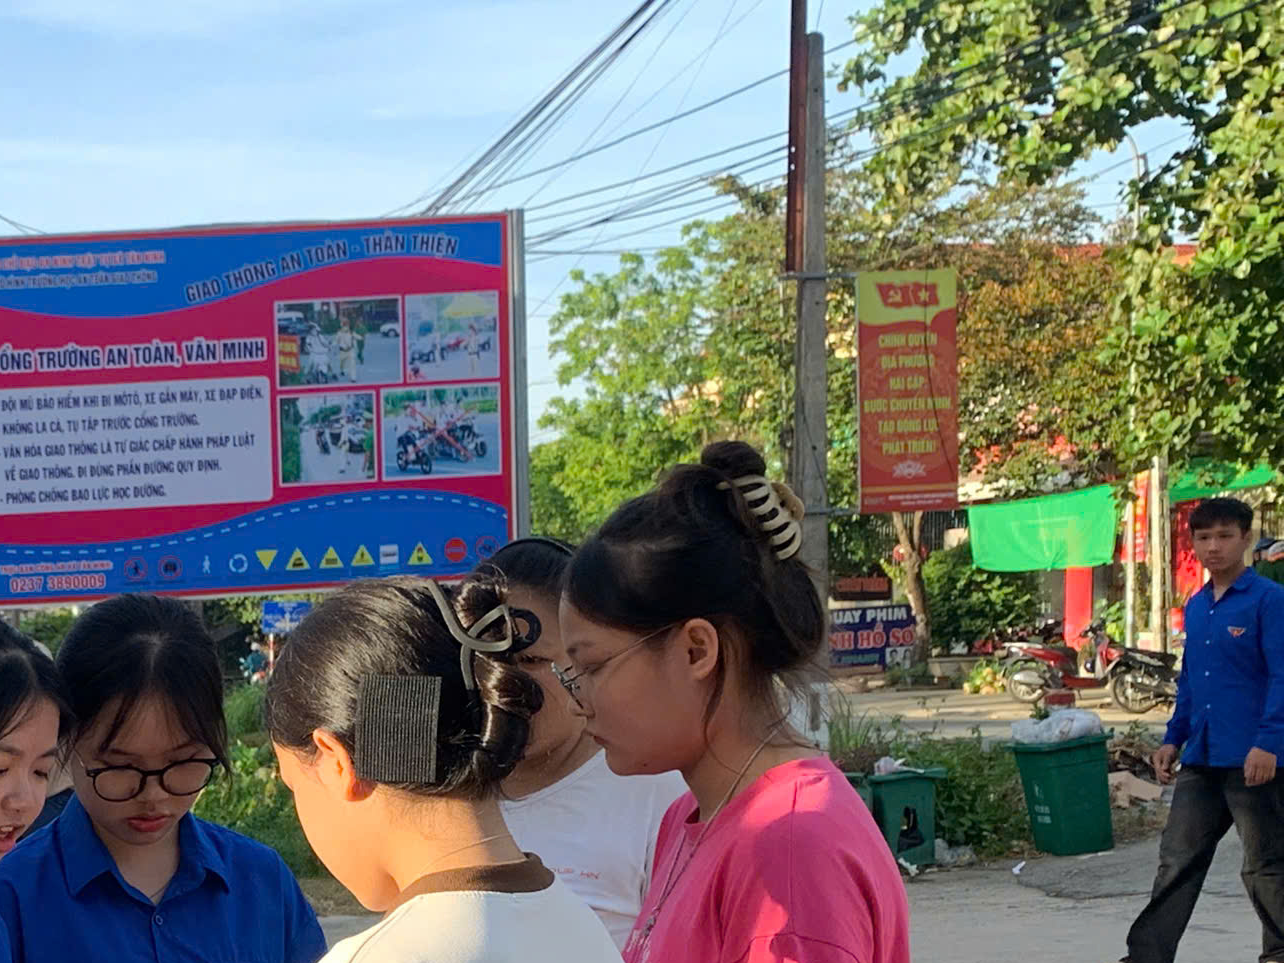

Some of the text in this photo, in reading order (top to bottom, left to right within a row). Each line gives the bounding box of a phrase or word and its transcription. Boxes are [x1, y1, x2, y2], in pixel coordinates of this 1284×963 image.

[186, 231, 458, 302] GIAO THÔNG AN TOÀN THÂN THIỆN
[37, 344, 101, 369] TRƯỜNG
[107, 347, 128, 366] AN
[133, 341, 181, 364] TOÀN,
[184, 339, 217, 361] VĂN
[222, 340, 265, 360] MINH
[1, 396, 16, 412] ĐỘI
[20, 395, 33, 410] MŨ
[37, 393, 55, 410] BẢO
[57, 390, 80, 409] HIỂM
[84, 395, 99, 408] KHI
[102, 395, 111, 407] ĐI
[145, 392, 156, 405] XE
[180, 387, 202, 404] MÁY,
[205, 389, 215, 402] XE
[219, 388, 238, 403] ĐẠP
[2, 420, 33, 435] KHÔNG
[36, 422, 47, 434] LA
[102, 415, 132, 431] TRƯỚC
[135, 410, 158, 429] CỔNG
[3, 444, 21, 459] VĂN
[45, 444, 65, 457] GIAO
[68, 440, 98, 456] THÔNG
[101, 440, 112, 454] LÀ
[115, 440, 127, 456] TỰ
[129, 436, 150, 453] GIÁC
[153, 434, 177, 452] CHẤP
[179, 435, 204, 450] HÀNH
[206, 433, 230, 449] PHÁP
[233, 432, 255, 450] LUẬT
[4, 464, 16, 481] VỀ
[19, 467, 40, 480] GIAO
[78, 466, 87, 478] ĐI
[90, 461, 114, 477] ĐÚNG
[117, 459, 141, 476] PHẦN
[143, 459, 175, 475] ĐƯỜNG
[177, 460, 194, 475] QUY
[6, 488, 36, 504] PHÒNG
[38, 486, 69, 503] CHỐNG
[71, 488, 90, 503] BẠO
[92, 487, 110, 502] LỰC
[113, 486, 131, 501] HỌC
[10, 573, 106, 592] 0237 3890009
[832, 607, 907, 624] UAY PHIM
[889, 624, 916, 645] SƠ
